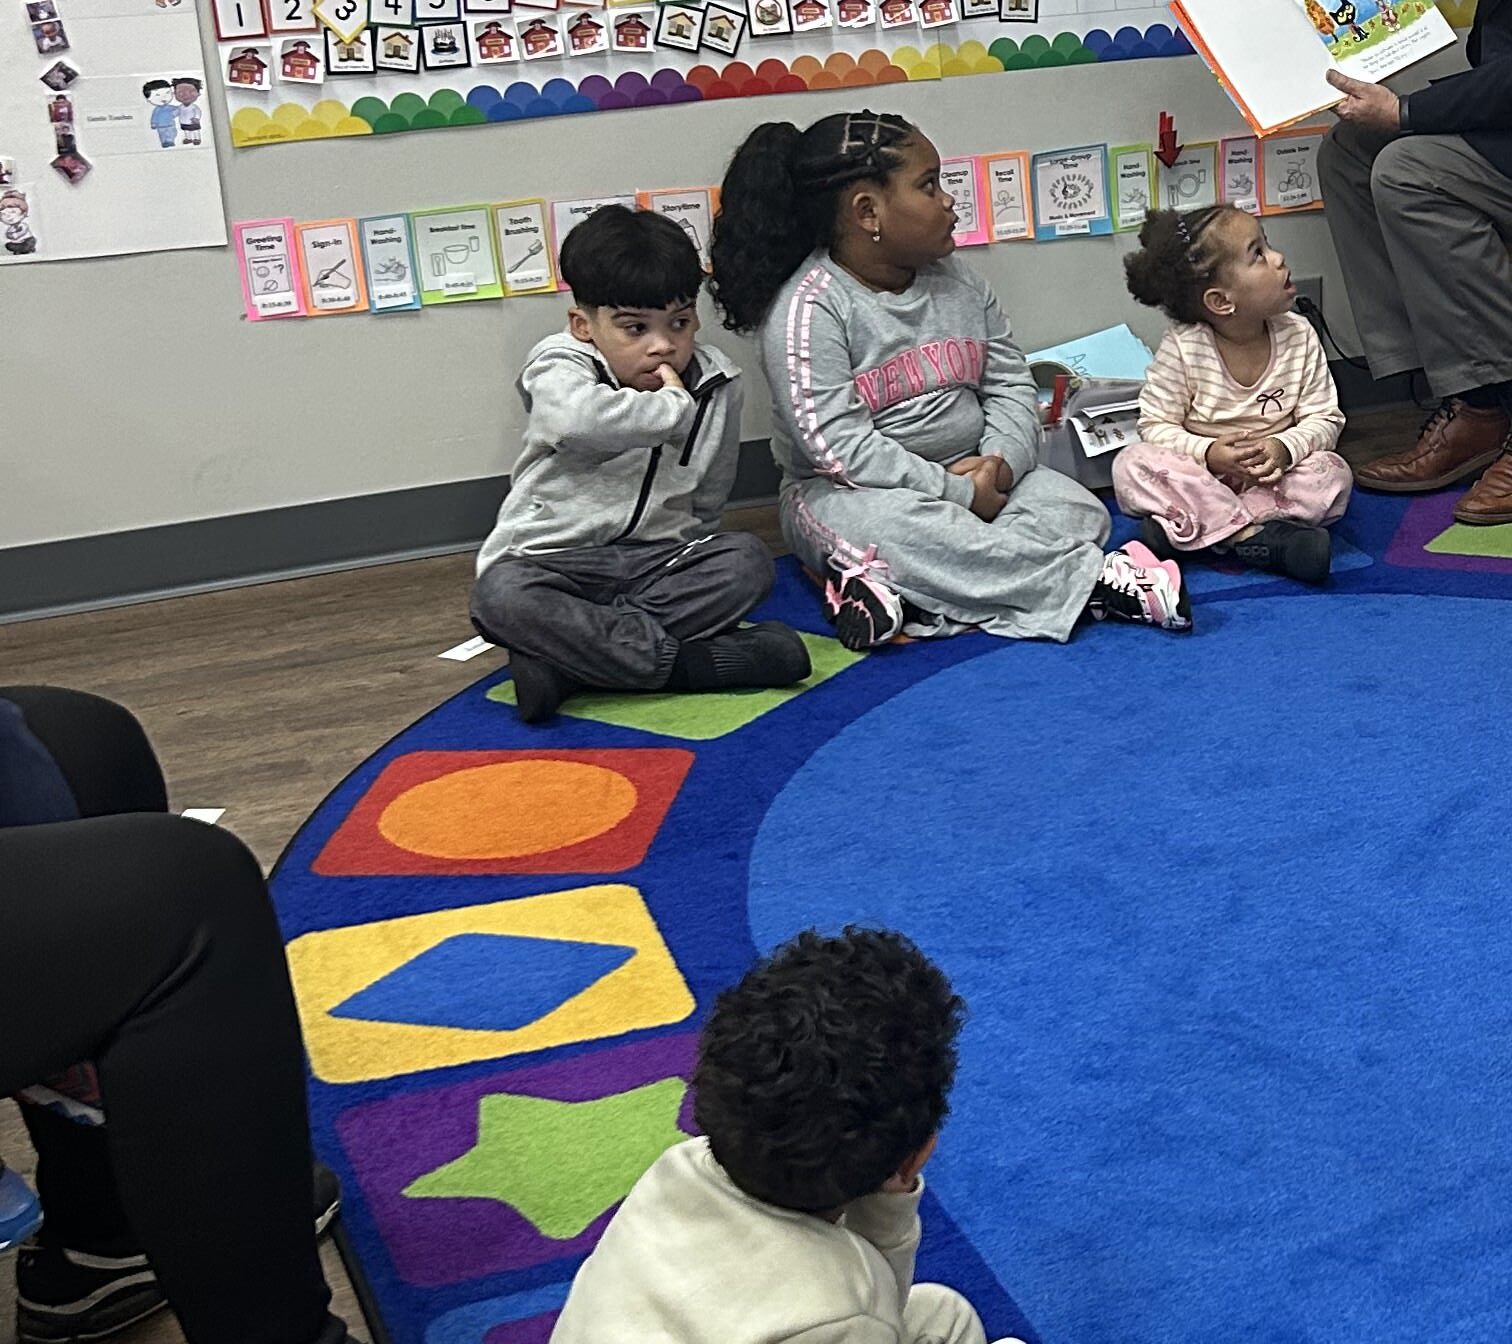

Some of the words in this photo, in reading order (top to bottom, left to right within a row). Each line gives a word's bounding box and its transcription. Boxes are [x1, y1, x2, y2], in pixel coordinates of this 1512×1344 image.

[236, 2, 244, 27] 1
[335, 0, 357, 21] 3
[246, 234, 283, 246] Greeting
[255, 243, 275, 251] Time
[855, 349, 925, 413] NEW
[920, 337, 989, 387] YOR
